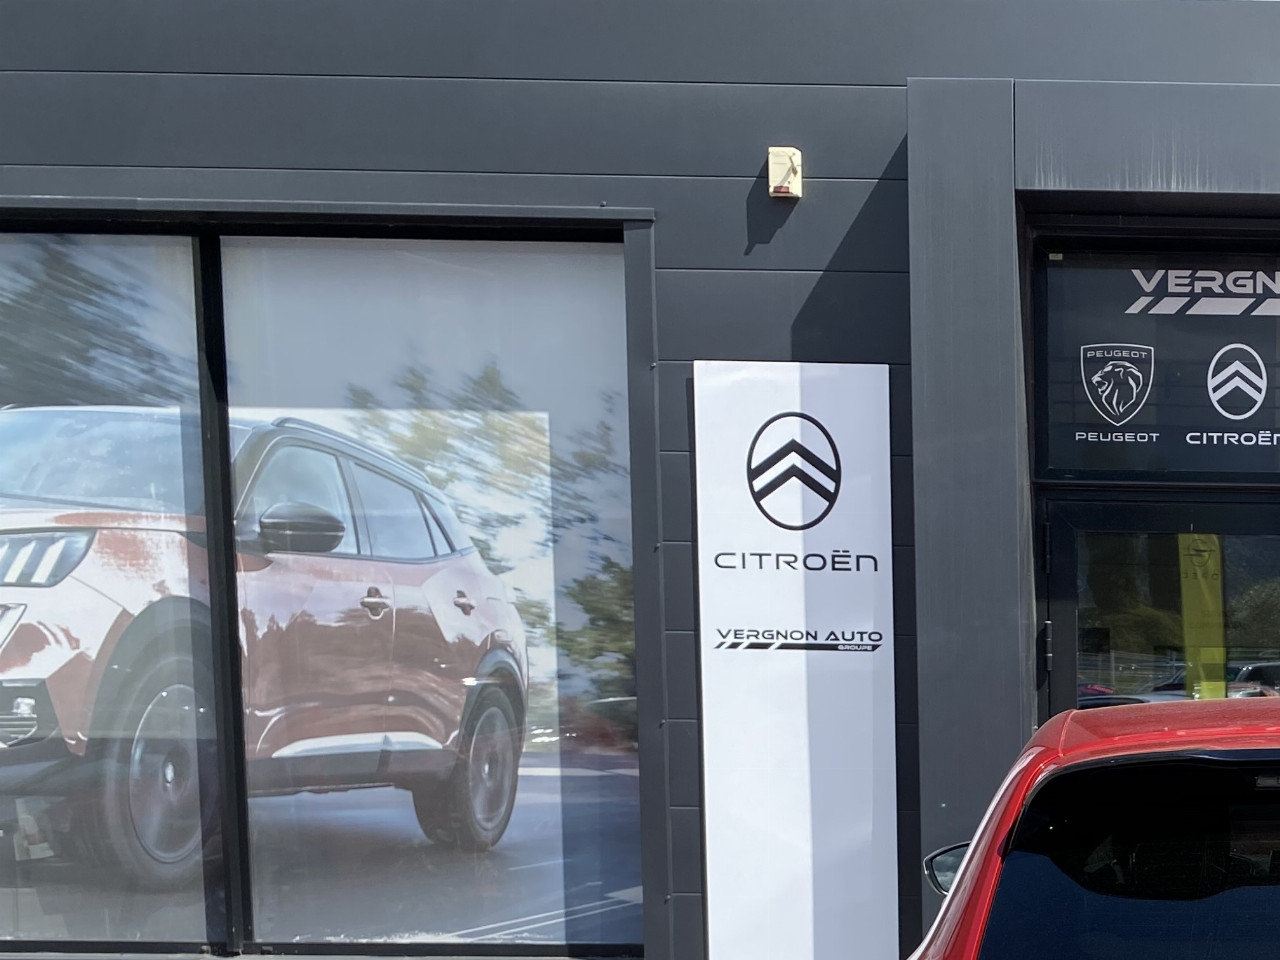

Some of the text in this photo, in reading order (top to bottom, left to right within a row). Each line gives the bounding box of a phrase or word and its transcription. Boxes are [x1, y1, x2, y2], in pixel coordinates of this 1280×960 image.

[1086, 348, 1148, 359] PEUGEOT
[1075, 431, 1160, 442] PEUGEOT
[714, 549, 879, 572] CITROËN
[716, 628, 883, 643] VERGNON AUTO
[838, 644, 873, 652] GROUPE
